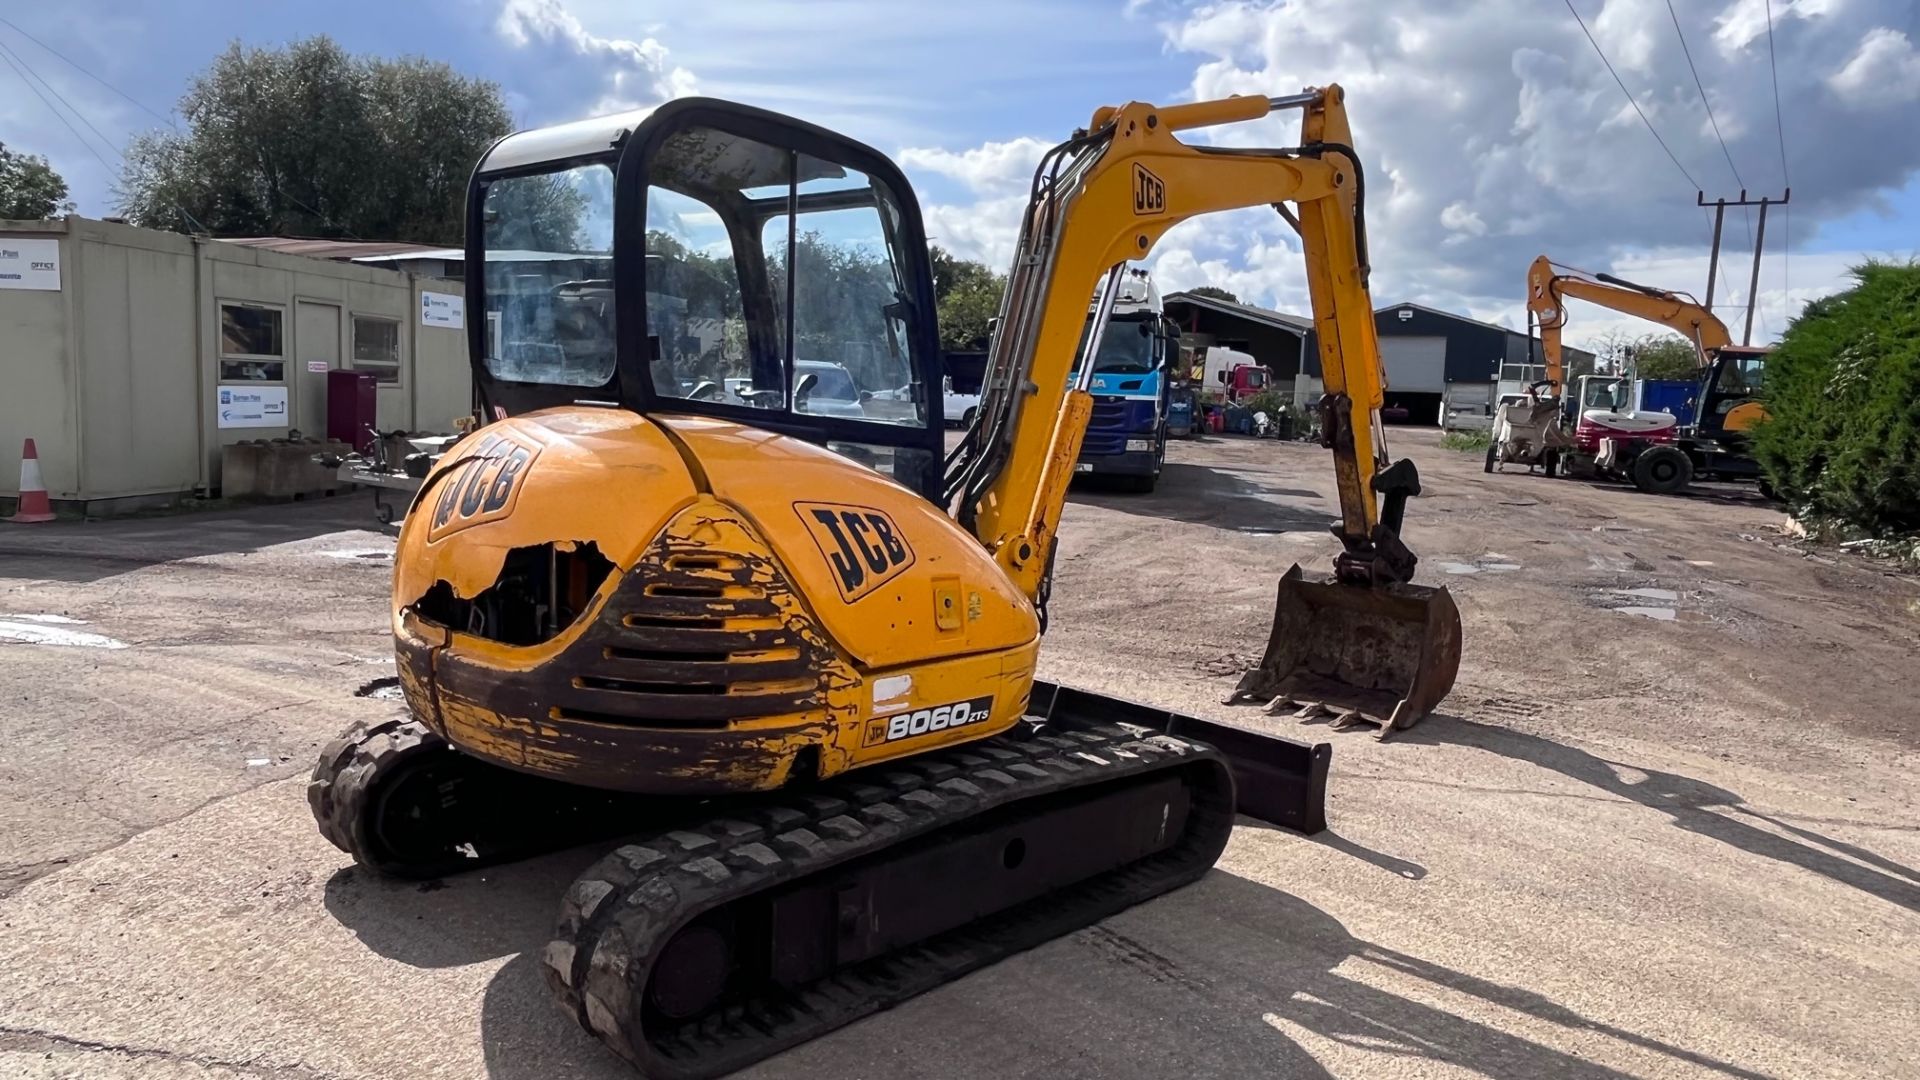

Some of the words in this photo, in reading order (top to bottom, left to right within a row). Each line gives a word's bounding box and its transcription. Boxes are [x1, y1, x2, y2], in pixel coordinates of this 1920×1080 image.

[1136, 169, 1163, 210] JCB
[432, 435, 531, 530] JCB
[810, 509, 907, 593] JCB
[887, 702, 971, 740] 8060
[968, 709, 989, 722] ZTS
